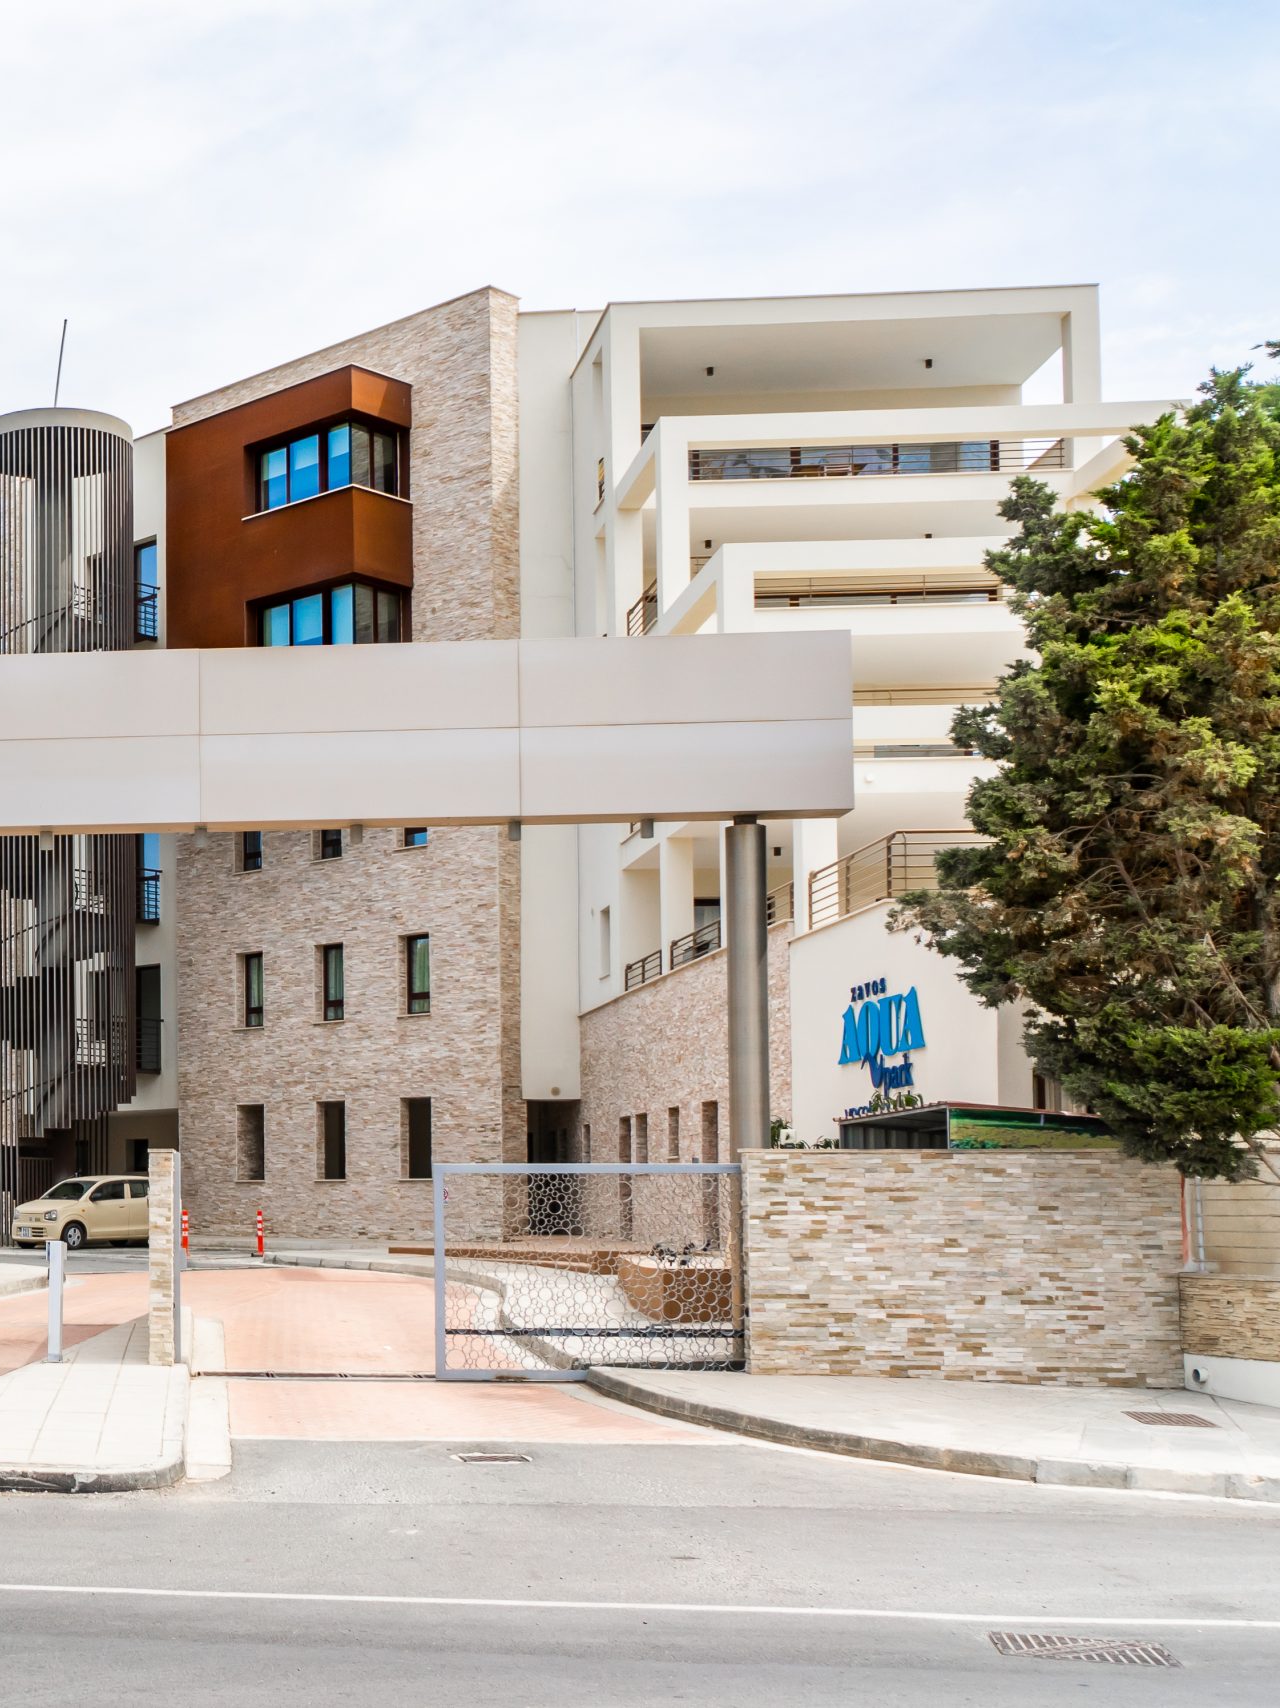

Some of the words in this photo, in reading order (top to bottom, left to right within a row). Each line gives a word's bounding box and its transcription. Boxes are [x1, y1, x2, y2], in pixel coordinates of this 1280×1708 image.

[851, 977, 887, 1003] zavos
[838, 985, 926, 1089] AQUA
[882, 1052, 914, 1098] park
